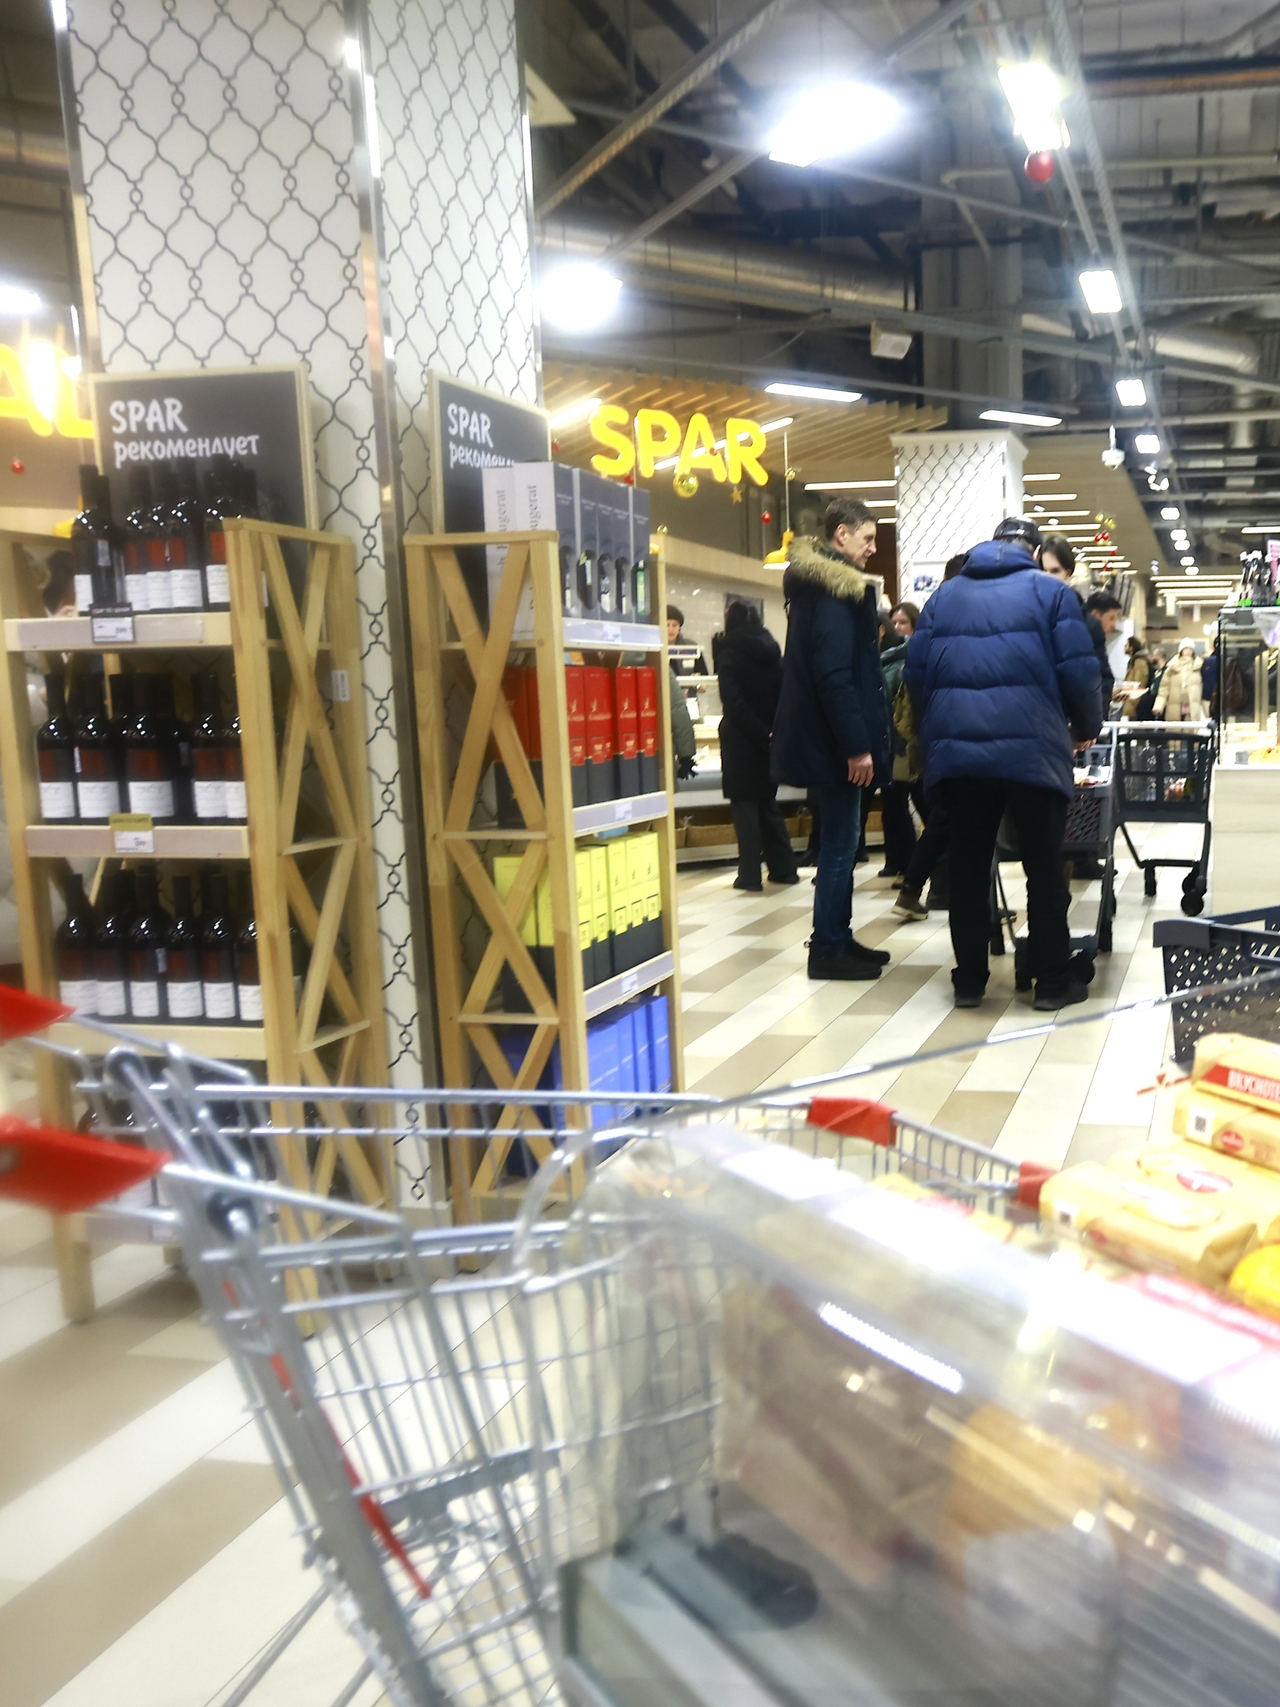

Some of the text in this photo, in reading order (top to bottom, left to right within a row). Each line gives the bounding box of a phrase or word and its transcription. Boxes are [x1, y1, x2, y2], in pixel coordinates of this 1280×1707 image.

[109, 397, 189, 434] SPAR
[447, 402, 494, 449] SPAR
[589, 404, 769, 486] SPAR
